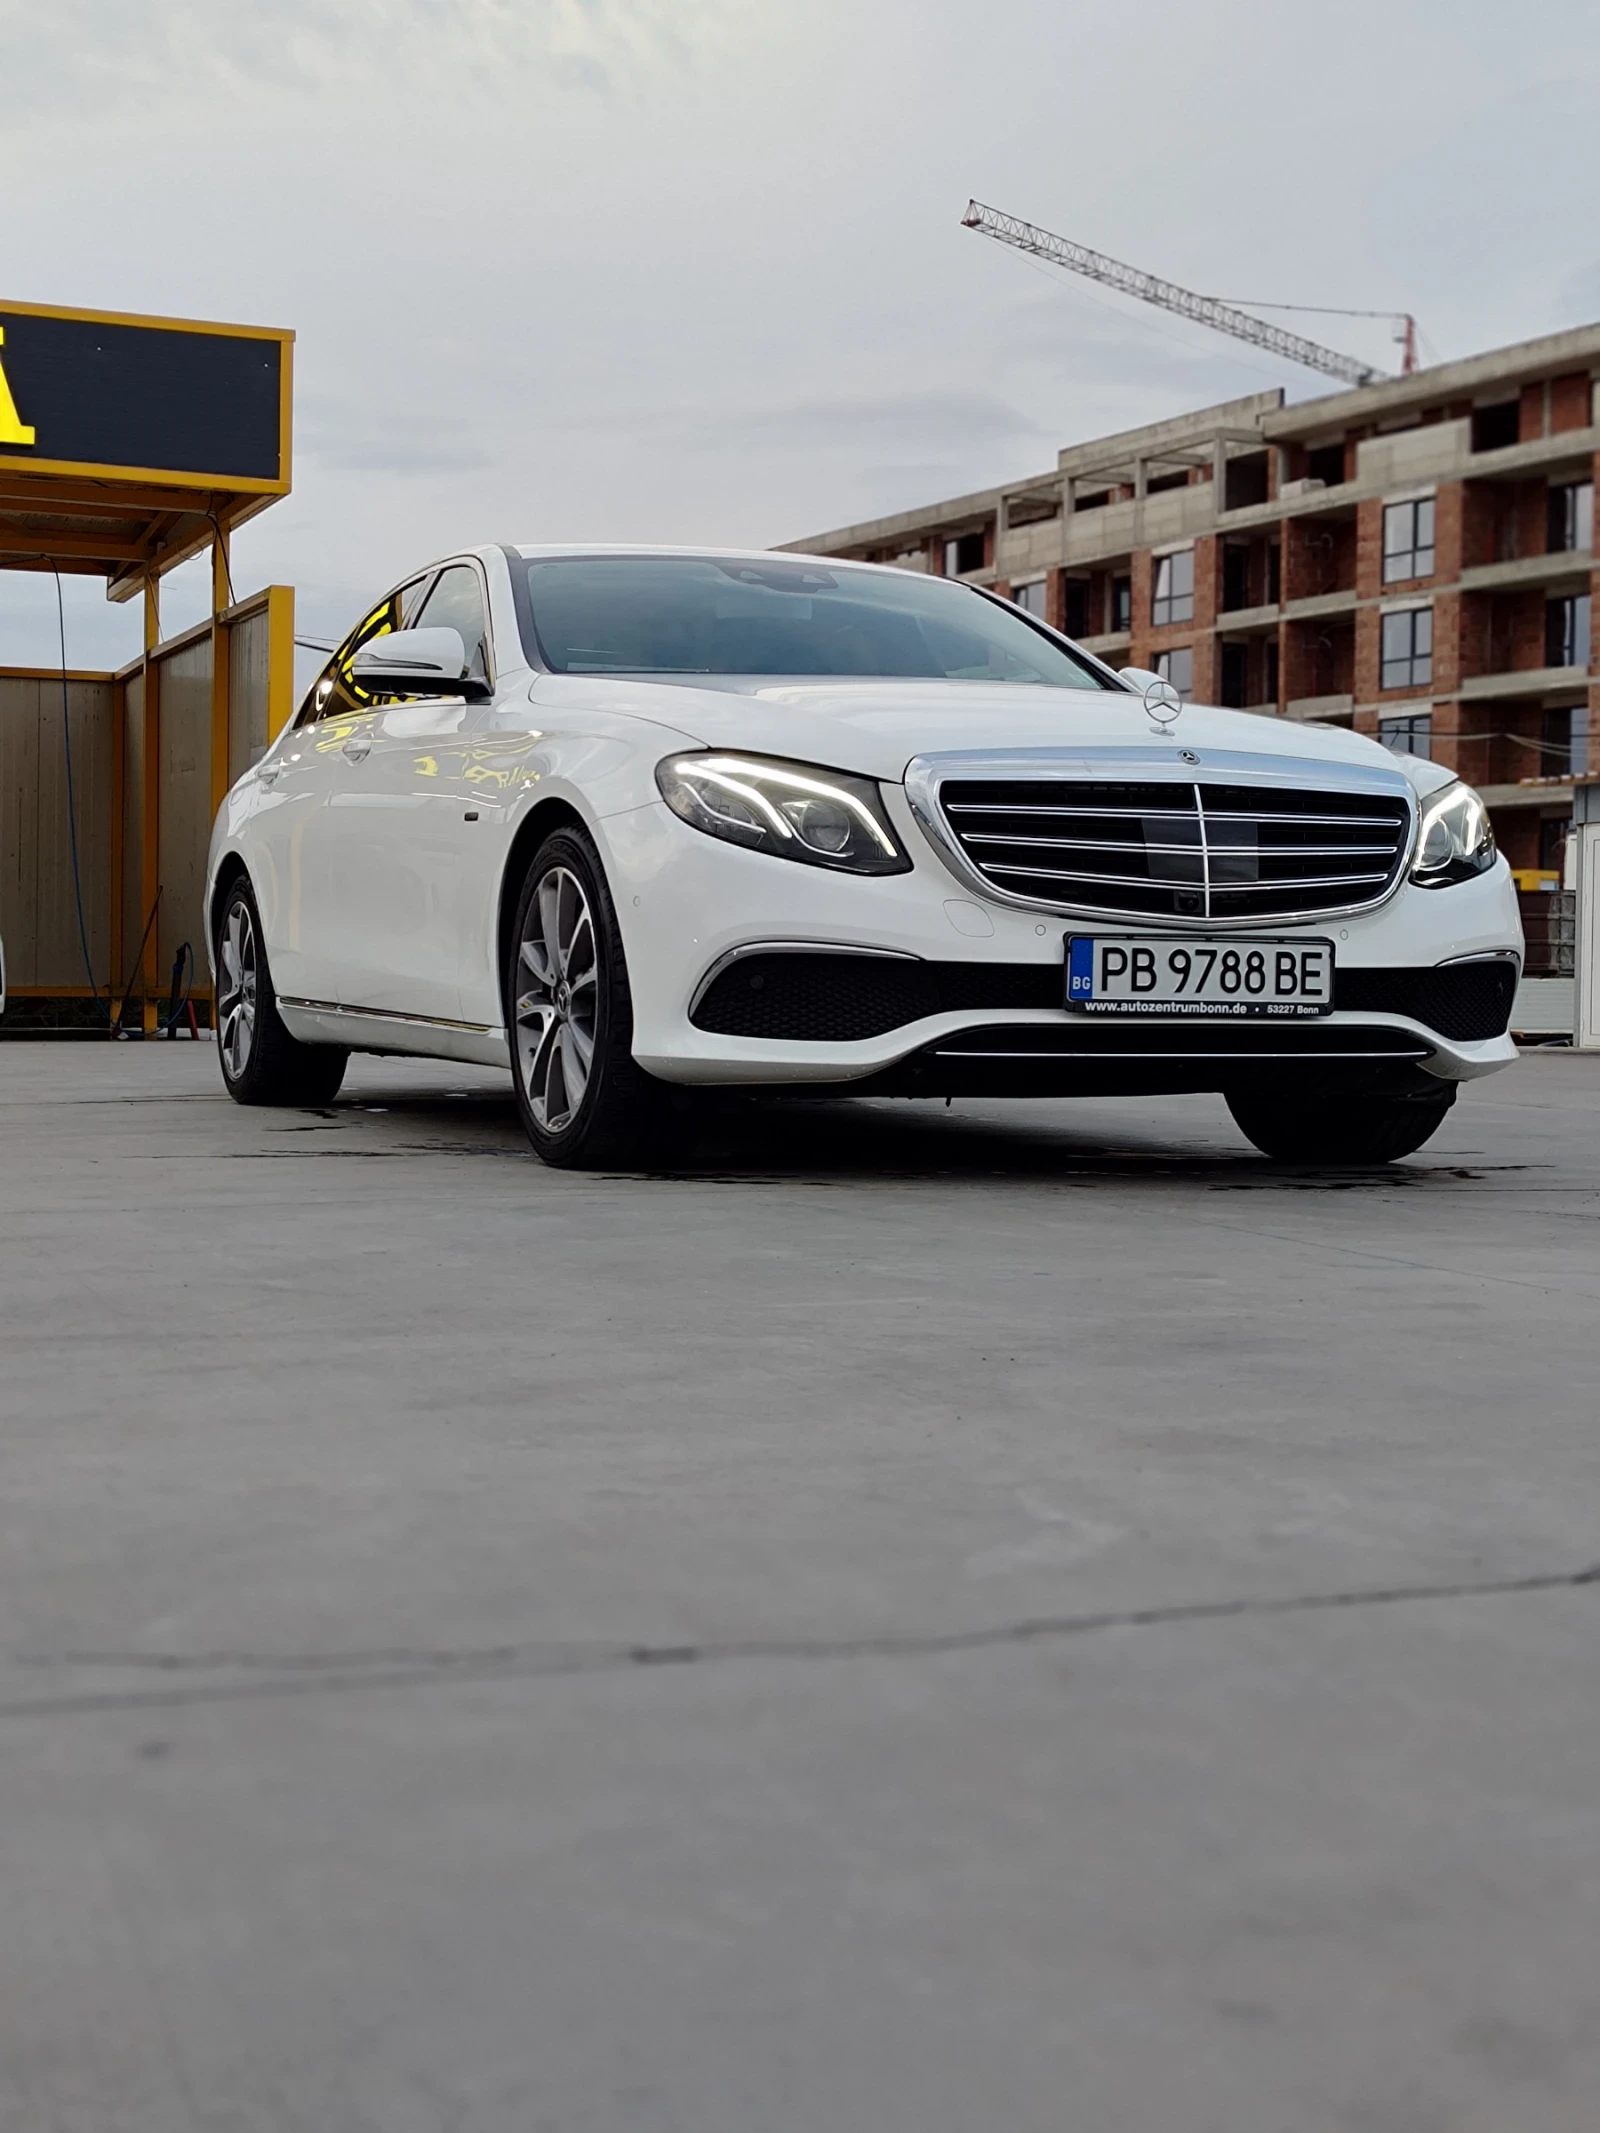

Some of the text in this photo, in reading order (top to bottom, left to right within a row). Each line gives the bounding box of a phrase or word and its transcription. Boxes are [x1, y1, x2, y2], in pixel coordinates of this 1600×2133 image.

[1101, 946, 1323, 996] PB 9788 BE
[1072, 976, 1091, 990] BG
[1085, 1001, 1319, 1015] www.autozentrumbonn.de 53227 Bonn
